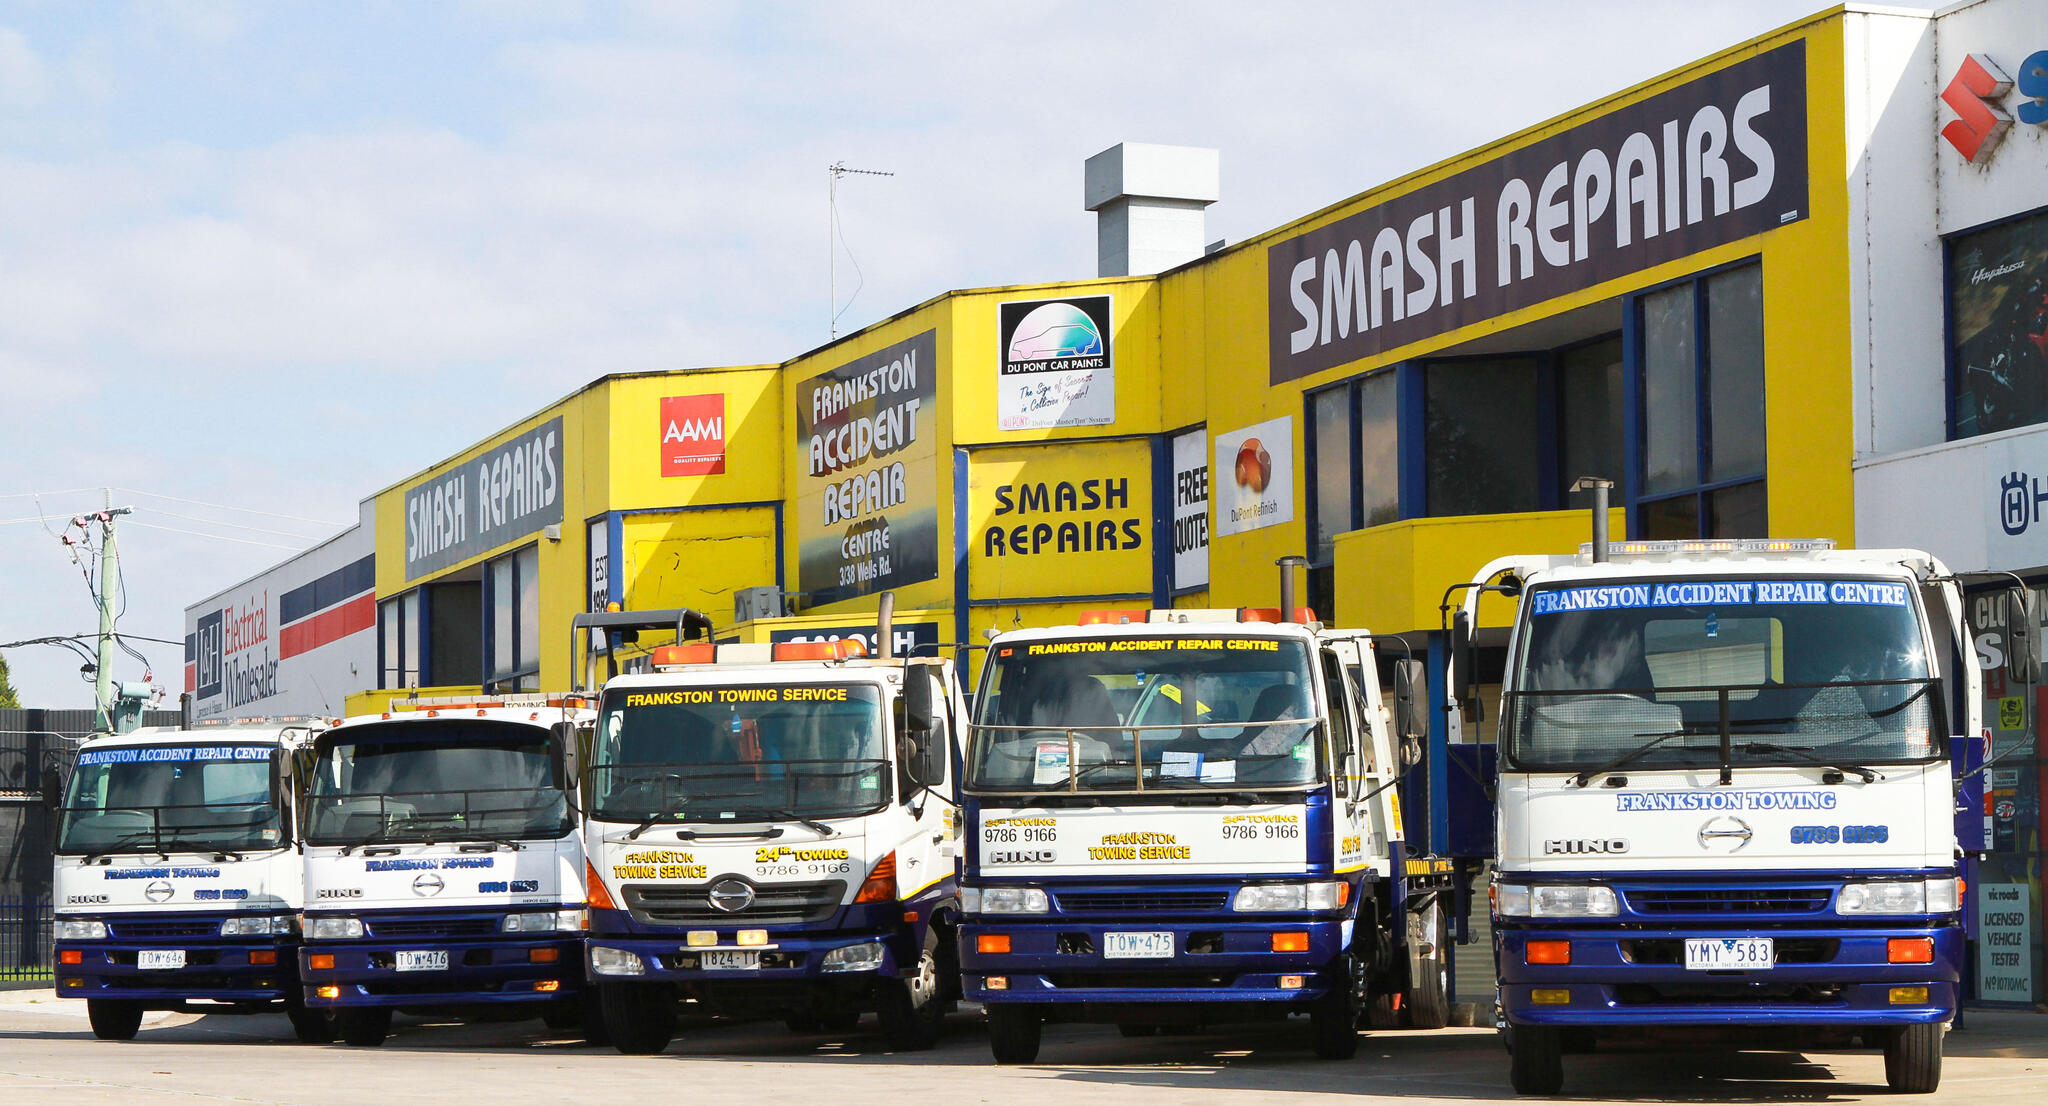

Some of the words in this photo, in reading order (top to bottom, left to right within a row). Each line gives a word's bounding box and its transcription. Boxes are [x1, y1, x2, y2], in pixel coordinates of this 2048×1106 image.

[1290, 197, 1477, 355] SMASH
[1496, 85, 1776, 287] REPAIRS
[1971, 260, 2026, 284] Hayabusa
[1007, 364, 1021, 373] DU
[1023, 362, 1048, 372] PONT
[1050, 360, 1070, 370] CAR
[1071, 358, 1104, 369] PAINTS
[813, 349, 917, 425] FRANKSTON
[1020, 385, 1033, 400] The
[1036, 382, 1052, 397] Sign
[663, 416, 722, 444] AAMI
[808, 398, 921, 477] ACCIDENT
[824, 462, 906, 526] REPAIR
[1177, 465, 1208, 508] FREE
[409, 474, 466, 563] SMASH
[479, 430, 557, 534] REPAIRS
[995, 477, 1128, 516] SMASH
[1231, 505, 1253, 523] DuPont
[1253, 501, 1278, 518] Refinish
[841, 527, 890, 559] CENTRE
[985, 519, 1142, 558] REPAIRS
[839, 561, 856, 587] 3/38
[857, 556, 878, 580] Wells
[879, 554, 893, 576] Rd.
[1535, 586, 1649, 614] FRANKSTON
[1653, 584, 1752, 606] ACCIDENT
[1757, 583, 1827, 604] REPAIR
[1830, 583, 1906, 606] CENTRE
[224, 588, 268, 656] Electrical
[199, 621, 221, 689] L&H
[1028, 642, 1107, 655] FRANKSTON
[1109, 640, 1174, 652] ACCIDENT
[1177, 640, 1223, 650] REPAIR
[1226, 639, 1279, 651] CENTRE
[224, 646, 279, 710] Wholesaler
[504, 701, 547, 709] TOWING
[626, 691, 713, 707] FRANKSTON
[718, 689, 778, 702] TOWING
[782, 688, 848, 701] SERVICE
[79, 749, 138, 765] FRANKSTON
[139, 748, 193, 761] ACCIDENT
[194, 748, 232, 760] REPAIR
[234, 748, 273, 760] CENTR
[1616, 792, 1744, 812] FRANKSTON
[1745, 791, 1837, 811] TOWING
[1007, 817, 1057, 826] TOWING
[1246, 815, 1298, 823] TOWING
[984, 828, 1017, 842] 9786
[1024, 828, 1057, 842] 9166
[1102, 832, 1176, 845] FRANKSTON
[1222, 825, 1257, 839] 9786
[1264, 825, 1299, 839] 9166
[1790, 825, 1840, 844] 9786
[1842, 825, 1889, 844] 9166
[792, 848, 849, 861] TOWING
[1088, 847, 1137, 860] TOWING
[1139, 846, 1190, 860] SERVICE
[1544, 838, 1630, 855] HINO
[625, 851, 693, 864] FRANKSTON
[991, 849, 1057, 863] HINO
[365, 859, 439, 872] FRANKSTON
[441, 858, 494, 869] TOWING
[613, 865, 656, 879] TOWING
[660, 865, 707, 878] SERVICE
[755, 864, 799, 876] 9786
[807, 862, 850, 875] 9166
[104, 868, 170, 880] FRANKSTON
[172, 868, 221, 878] TOWING
[67, 894, 110, 904] HINO
[316, 888, 364, 899] HINO
[1988, 888, 1998, 900] vic
[1999, 888, 2019, 900] roads
[1984, 912, 2025, 926] LICENSED
[1987, 932, 2022, 946] VEHICLE
[704, 951, 757, 966] 1824-TT
[1688, 943, 1721, 963] YMY
[1737, 943, 1769, 962] 583
[1991, 952, 2020, 967] TESTER
